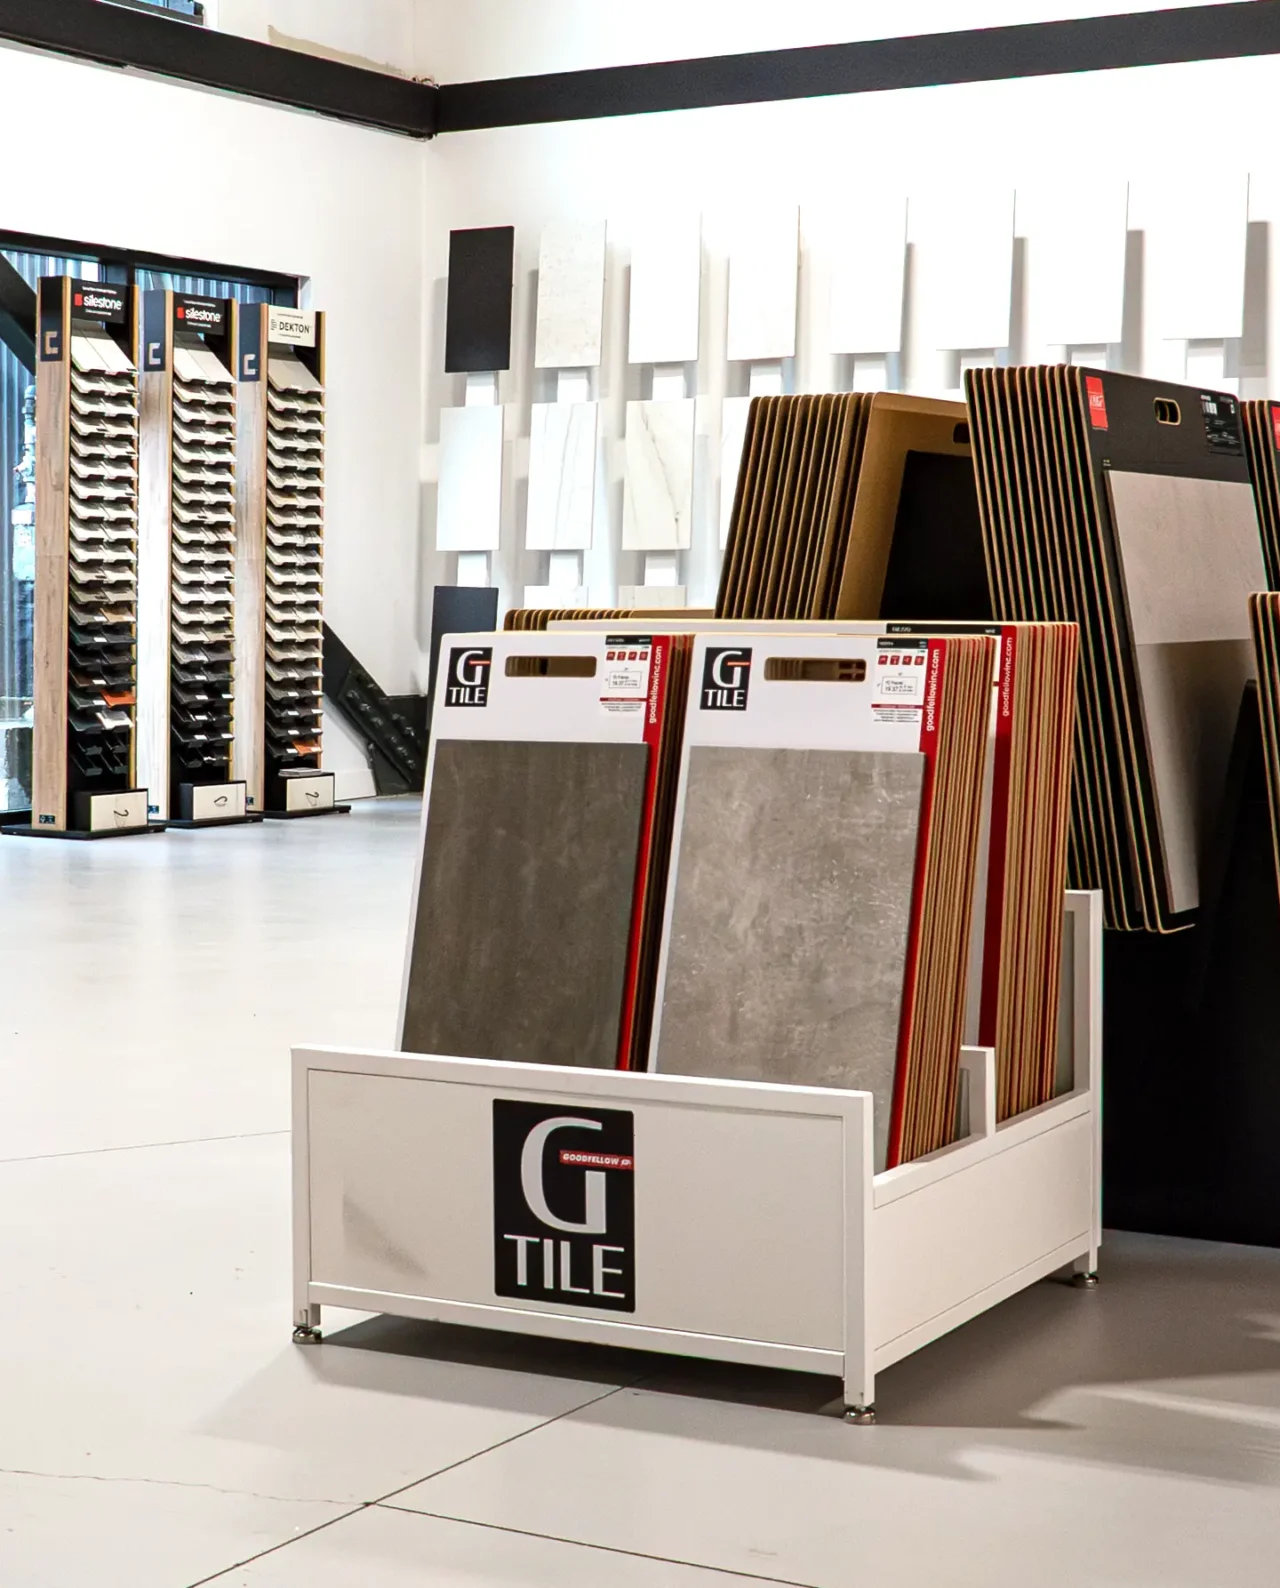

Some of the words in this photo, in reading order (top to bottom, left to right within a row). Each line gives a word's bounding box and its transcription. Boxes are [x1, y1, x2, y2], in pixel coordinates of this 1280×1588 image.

[84, 294, 122, 311] silestone
[185, 307, 221, 323] silestone
[279, 321, 310, 334] DEKTON
[456, 650, 484, 686] G
[649, 645, 663, 724] goodfellowinc.com
[712, 650, 743, 688] G
[1002, 637, 1013, 717] goodfellowinc.com
[449, 687, 486, 704] TILE
[704, 689, 745, 707] TILE
[926, 649, 940, 731] goodfellowinc.com
[520, 1116, 607, 1234] G
[563, 1153, 619, 1165] GOODFELLOW
[503, 1234, 626, 1298] TILE
